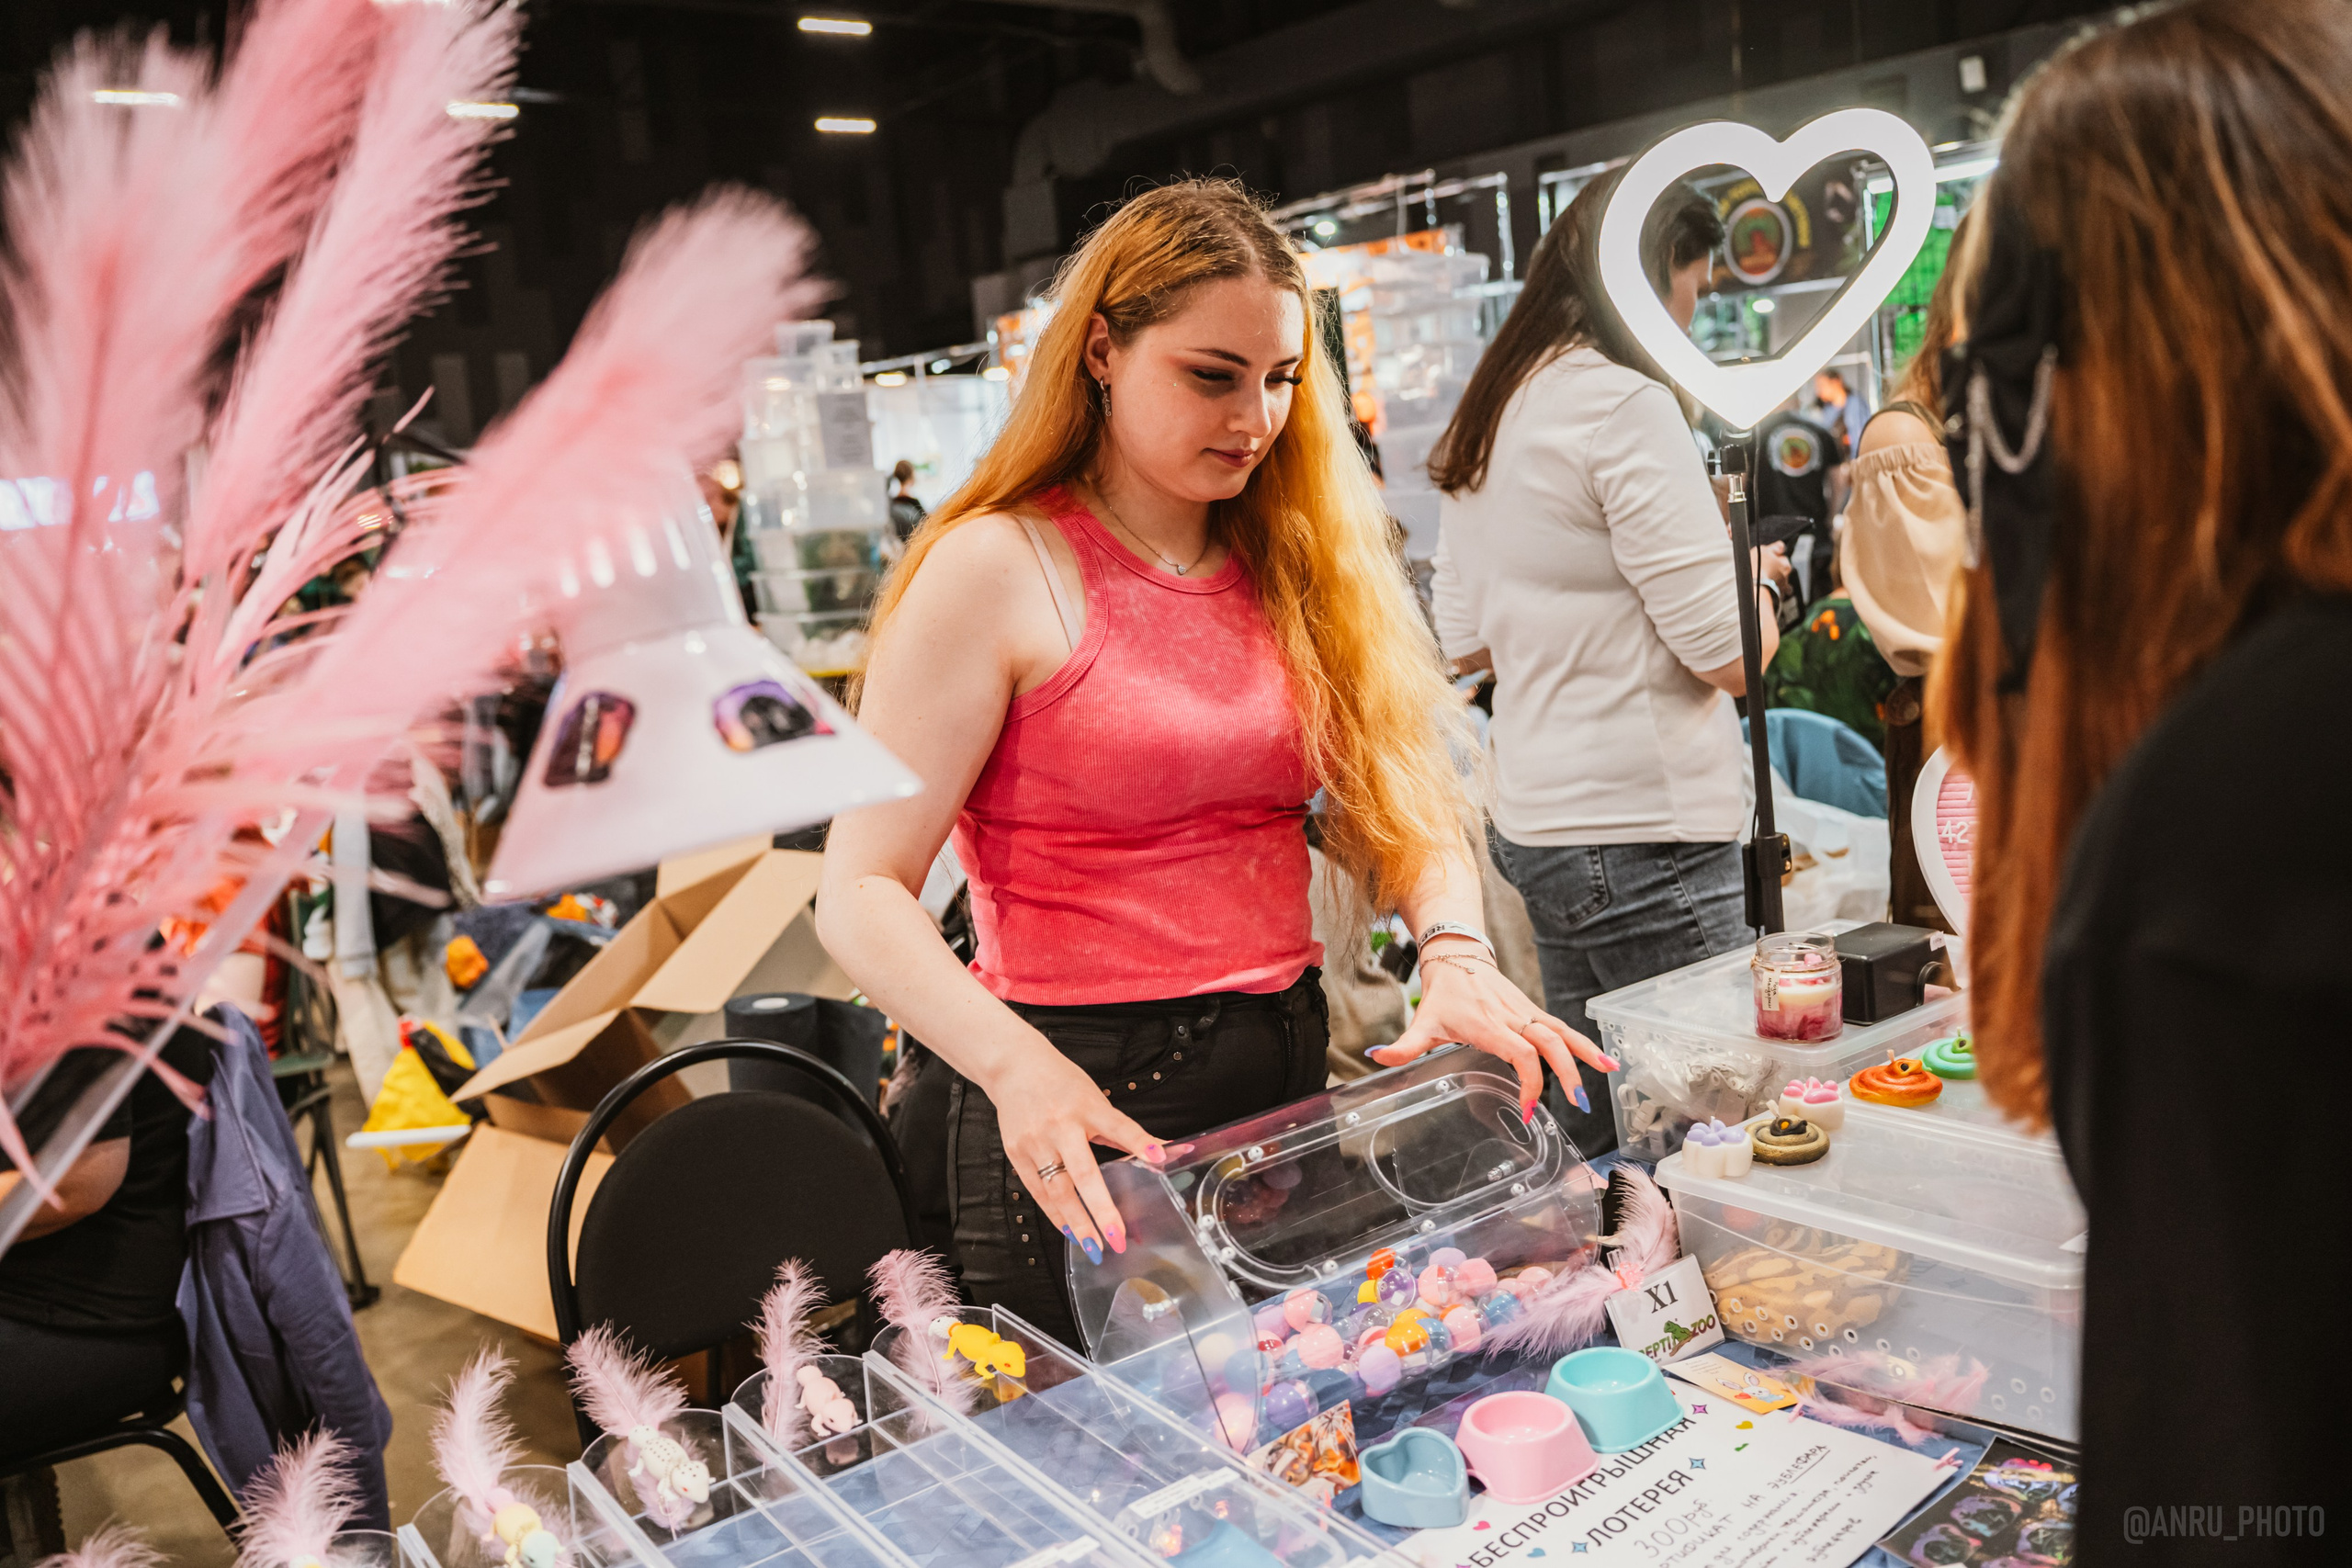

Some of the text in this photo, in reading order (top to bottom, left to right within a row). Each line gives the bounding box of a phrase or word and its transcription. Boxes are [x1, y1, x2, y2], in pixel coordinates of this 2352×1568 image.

[1941, 819, 1977, 844] 42
[1468, 1417, 1697, 1568] БЕСПРОИГРЫШНАЯ
[1587, 1470, 1694, 1547] ЛОТЕРЕЯ
